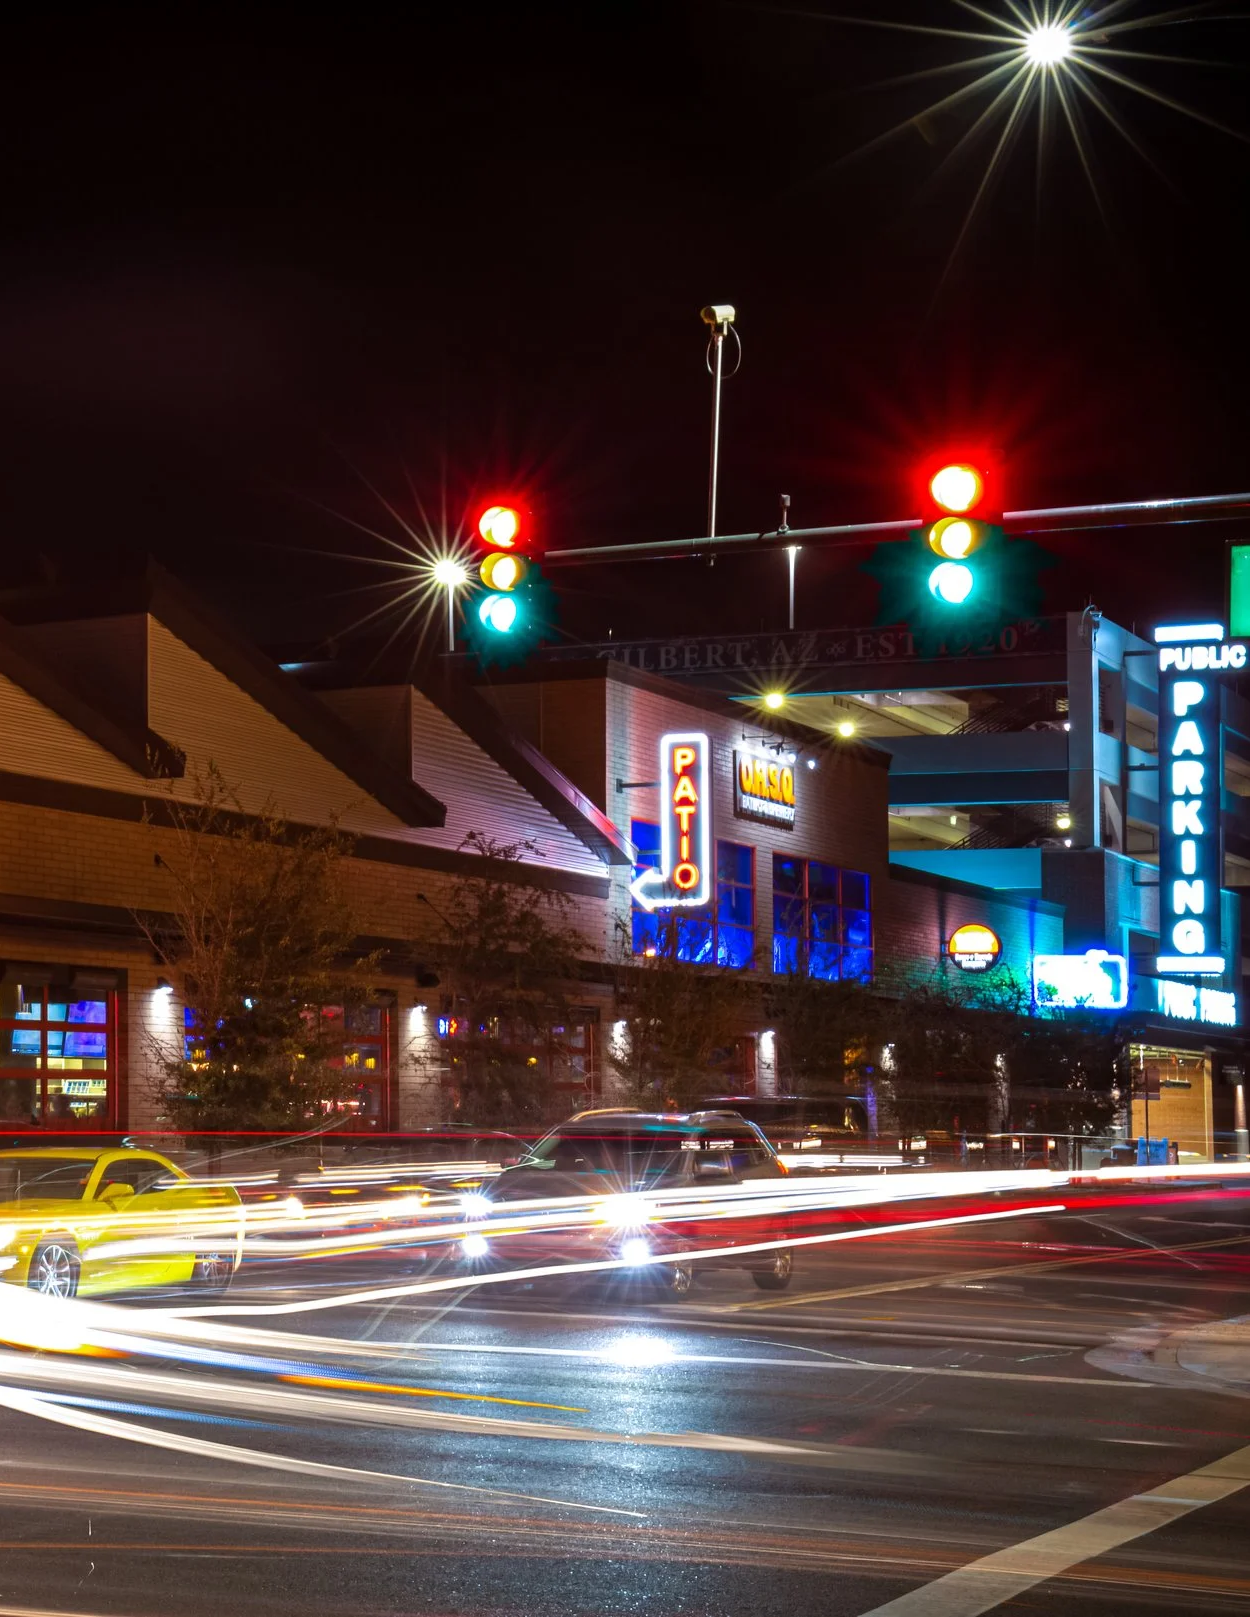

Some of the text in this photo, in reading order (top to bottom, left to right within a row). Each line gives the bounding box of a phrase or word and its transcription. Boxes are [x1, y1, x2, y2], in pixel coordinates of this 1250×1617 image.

[771, 633, 819, 664] AZ
[1159, 644, 1246, 672] PUBLIC
[673, 747, 699, 890] PATIO
[1171, 681, 1206, 955] PARKING
